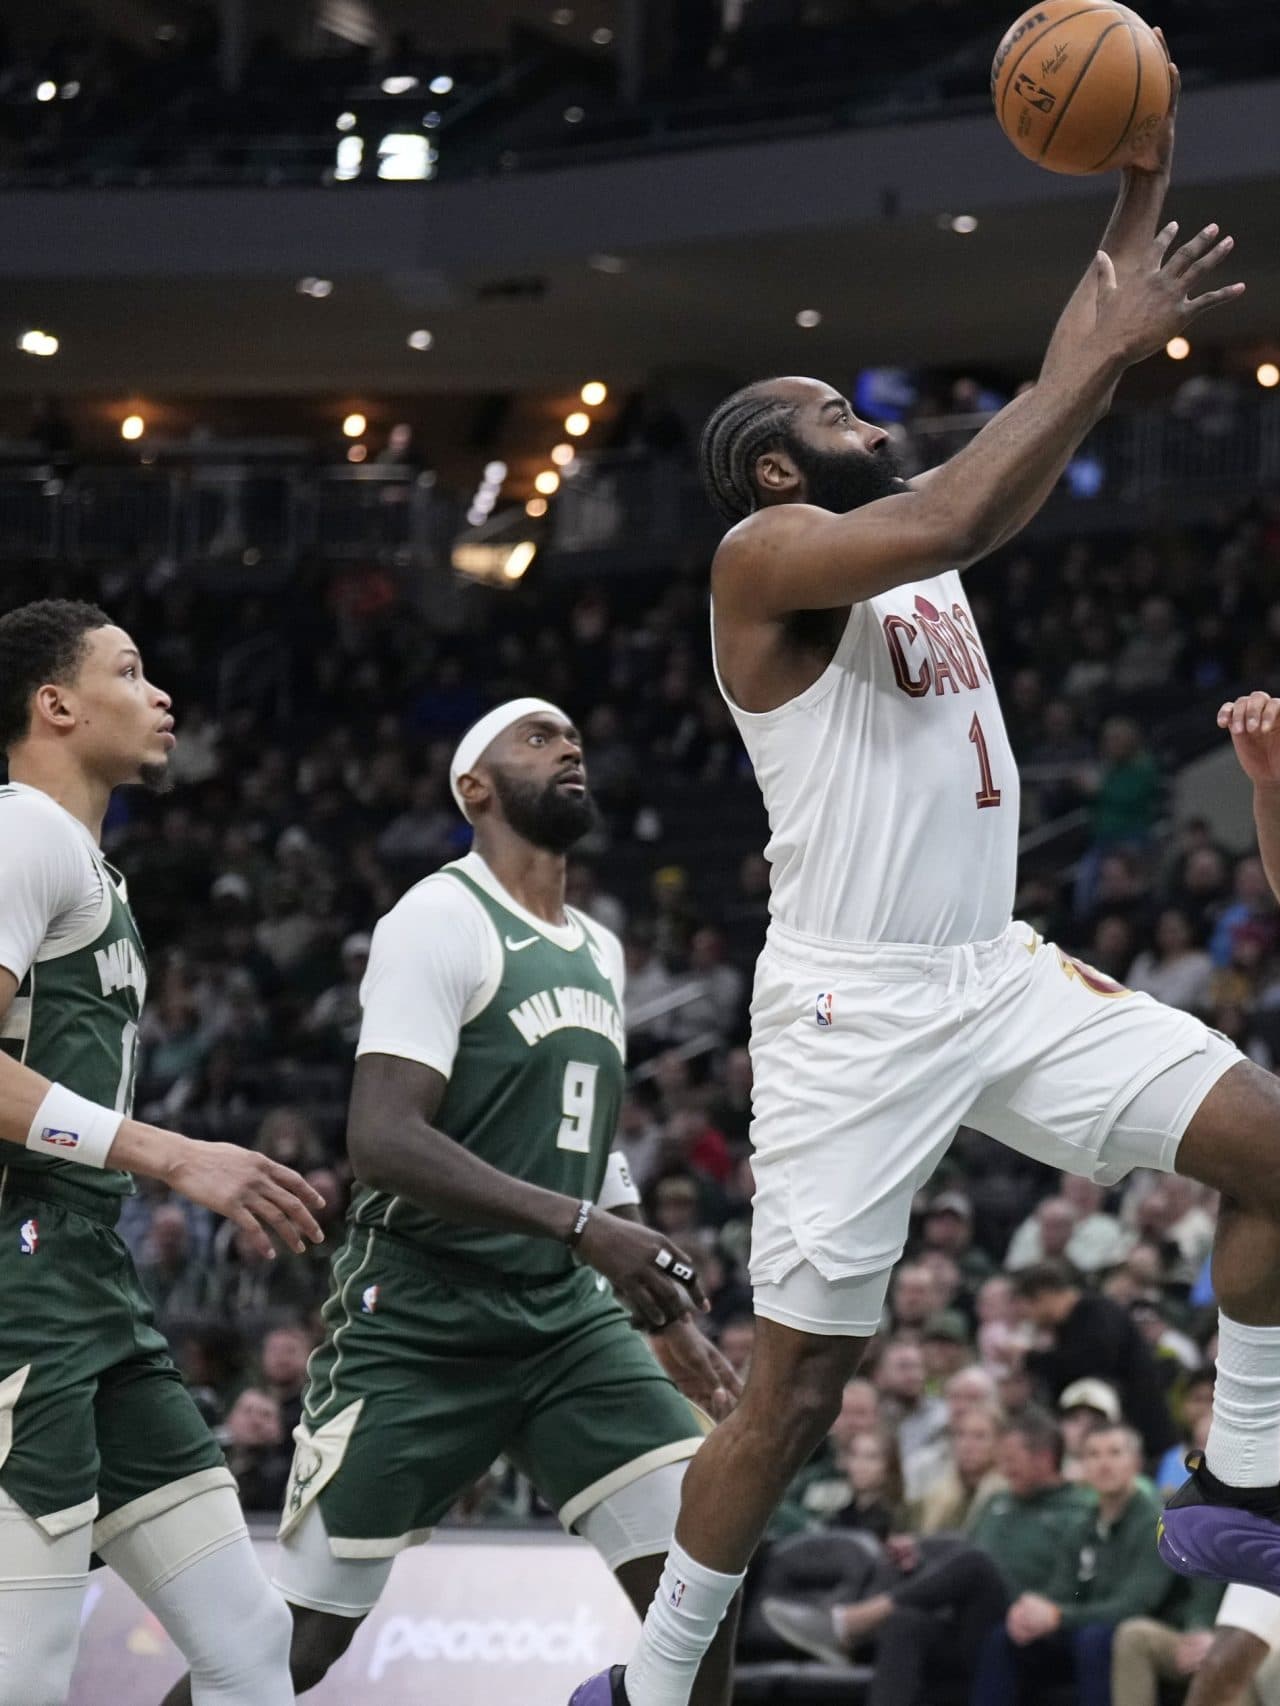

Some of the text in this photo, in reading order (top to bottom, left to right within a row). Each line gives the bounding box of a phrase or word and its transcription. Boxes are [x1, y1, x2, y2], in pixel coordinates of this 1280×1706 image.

[969, 711, 1001, 810] 1
[508, 986, 626, 1064] MILWAUKE
[556, 1060, 599, 1153] 9
[368, 1605, 600, 1680] peacock
